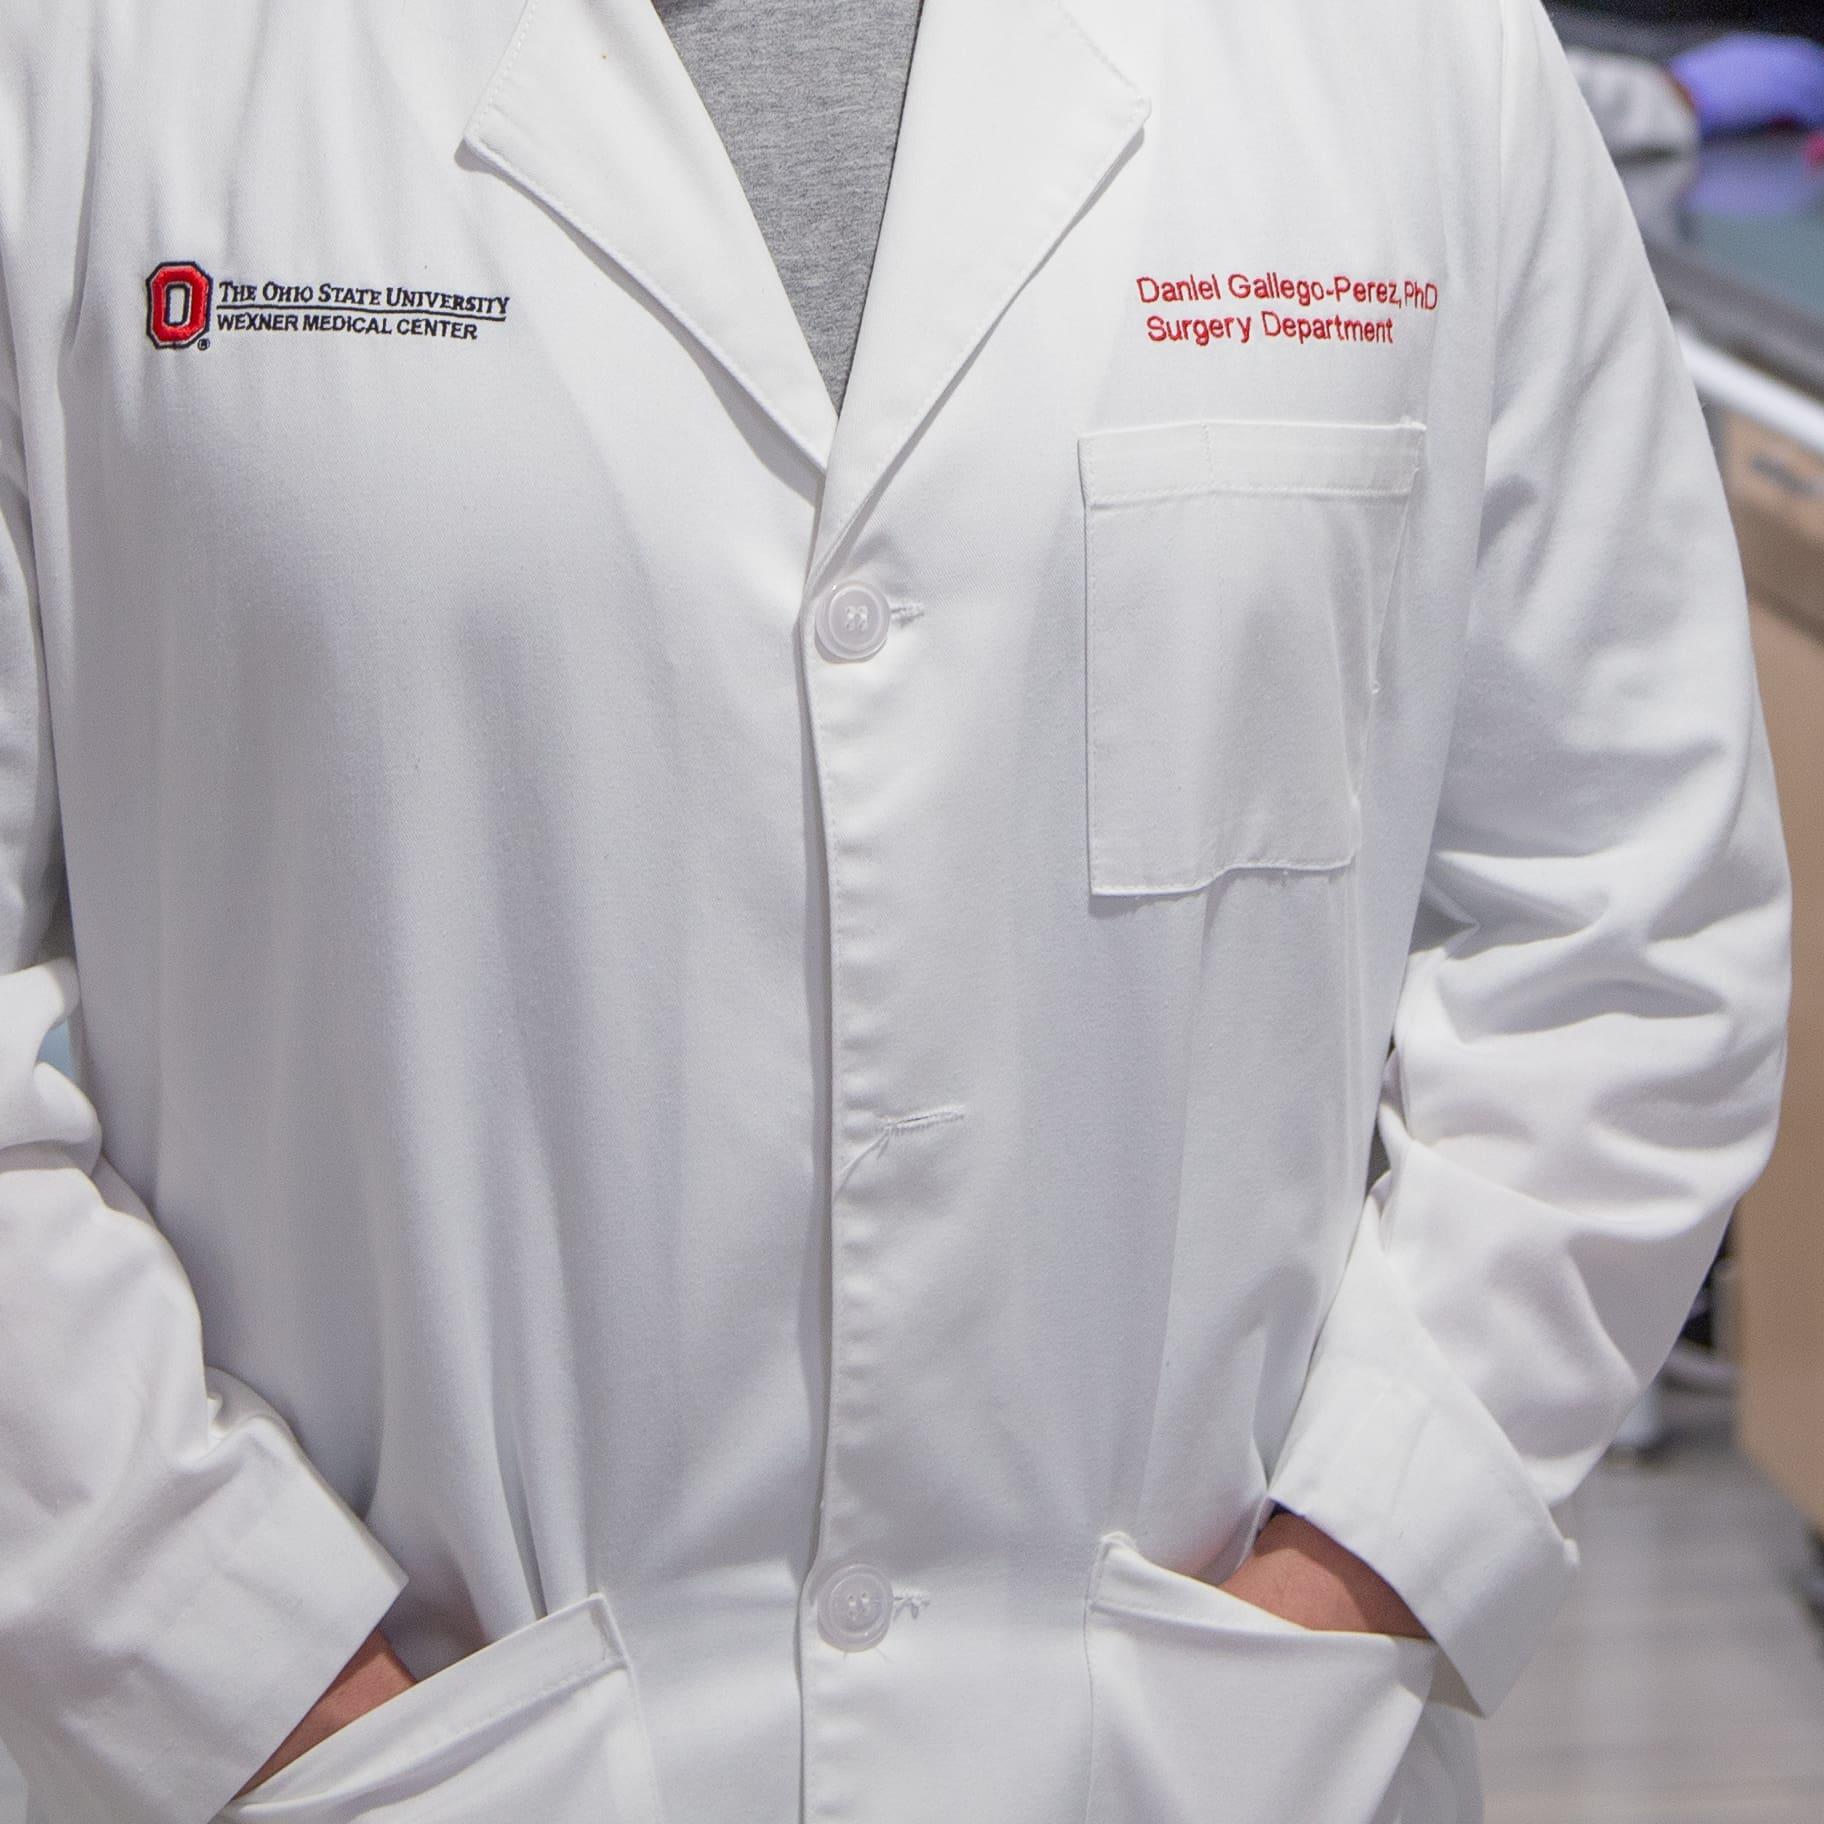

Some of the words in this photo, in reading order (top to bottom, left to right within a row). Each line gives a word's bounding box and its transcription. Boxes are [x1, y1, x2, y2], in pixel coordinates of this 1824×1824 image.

[262, 281, 314, 303] OHIO
[318, 283, 382, 306] STATE
[386, 286, 510, 315] UNIVERSITY
[1136, 273, 1221, 303] Daniel
[1403, 279, 1439, 310] PhD
[216, 312, 299, 332] WEXNER
[302, 314, 392, 336] MEDICAL
[396, 318, 478, 340] CENTER
[1145, 313, 1252, 346] Surgery
[1260, 309, 1394, 344] Department
